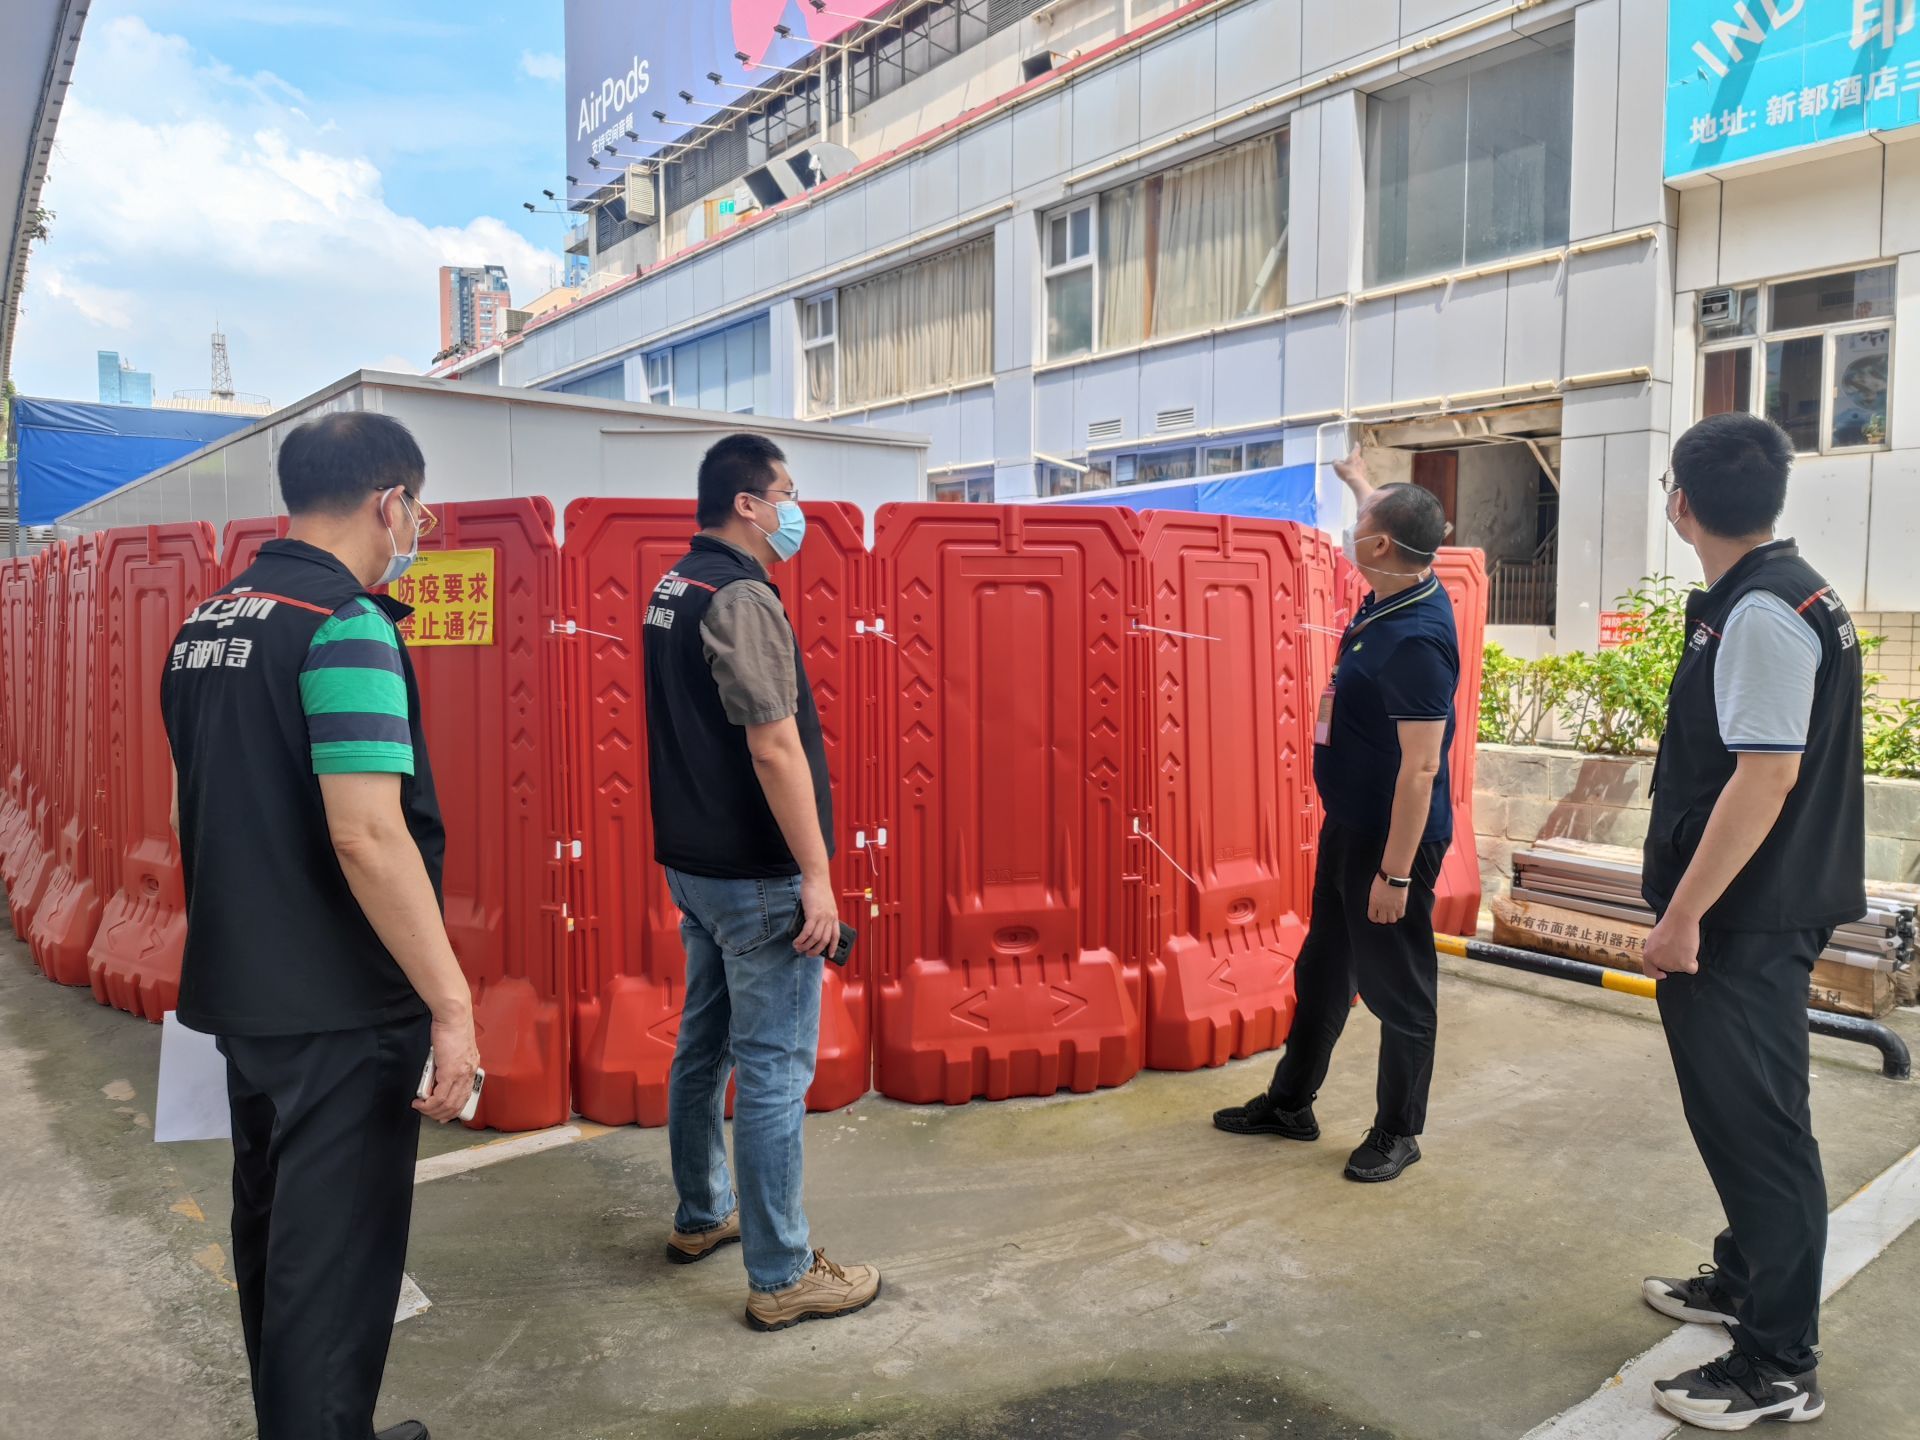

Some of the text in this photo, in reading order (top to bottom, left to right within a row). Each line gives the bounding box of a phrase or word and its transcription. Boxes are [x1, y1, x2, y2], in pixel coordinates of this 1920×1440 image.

[578, 55, 650, 142] AirPods
[398, 573, 489, 604] 防疫要求
[398, 610, 488, 641] 禁止通行
